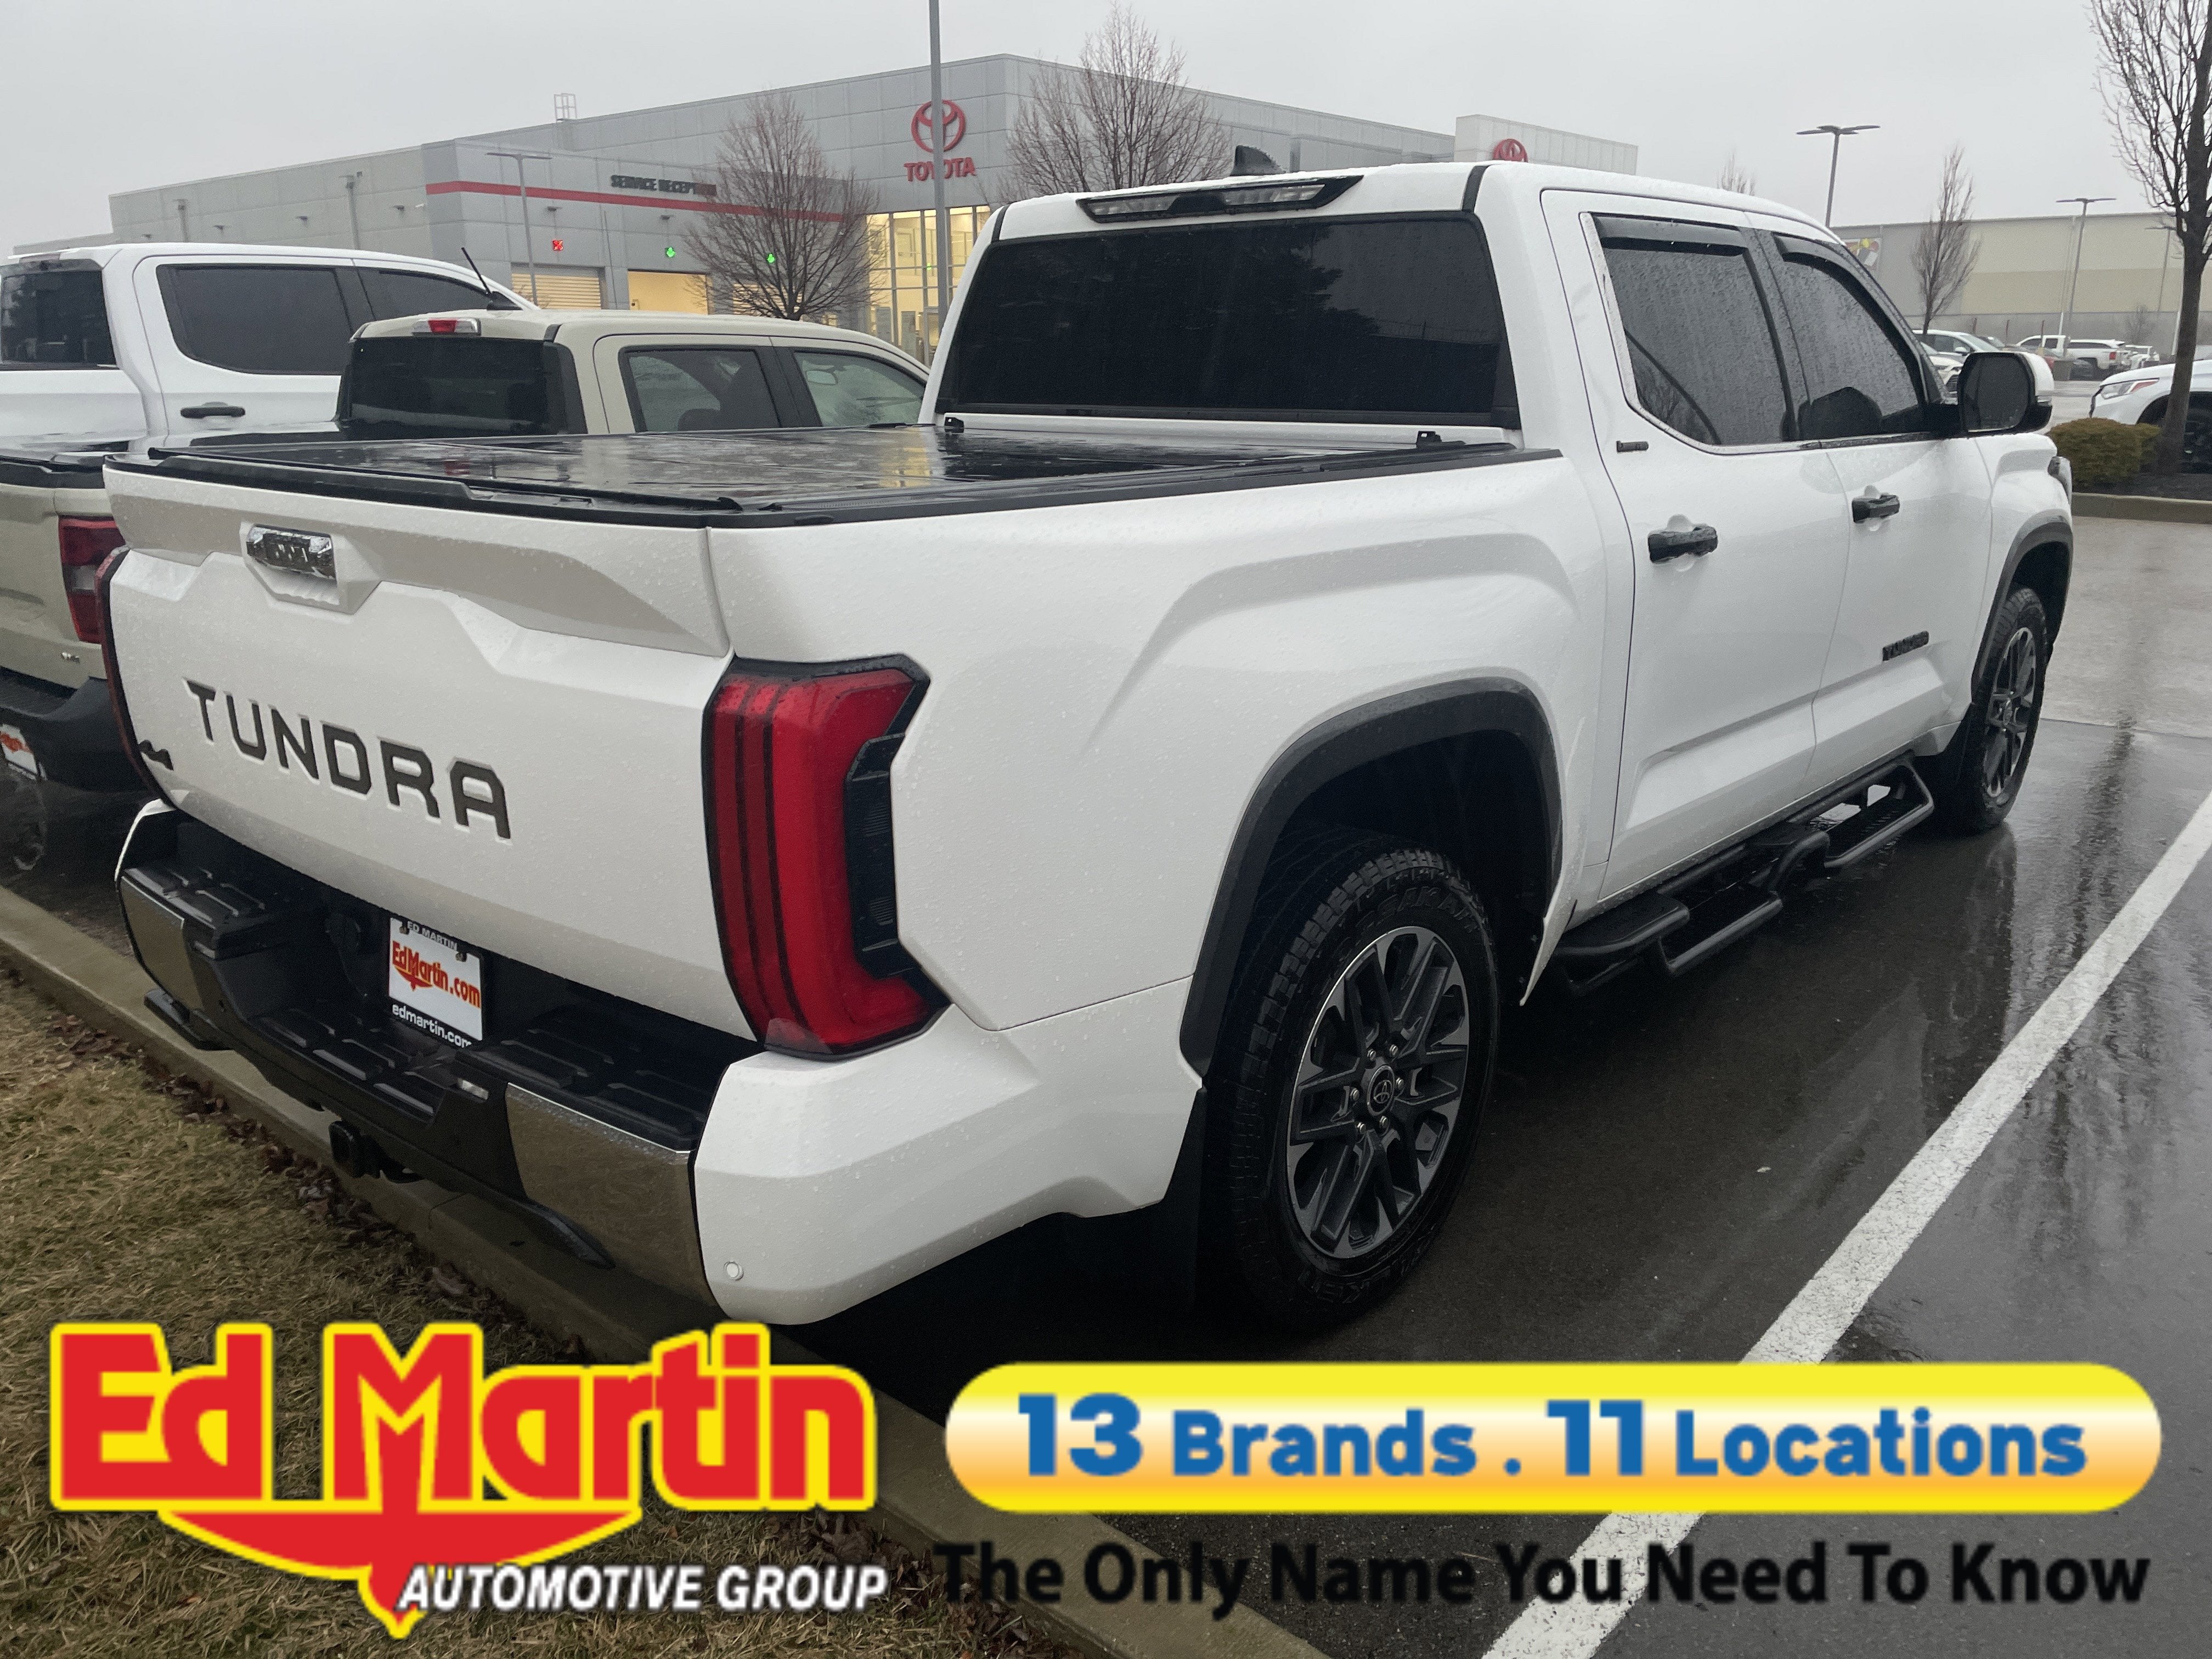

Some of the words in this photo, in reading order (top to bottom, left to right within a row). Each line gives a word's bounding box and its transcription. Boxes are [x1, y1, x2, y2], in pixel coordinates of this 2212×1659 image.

[184, 678, 512, 842] TUNDRA
[407, 921, 420, 934] ED
[422, 929, 458, 952] MARTIN
